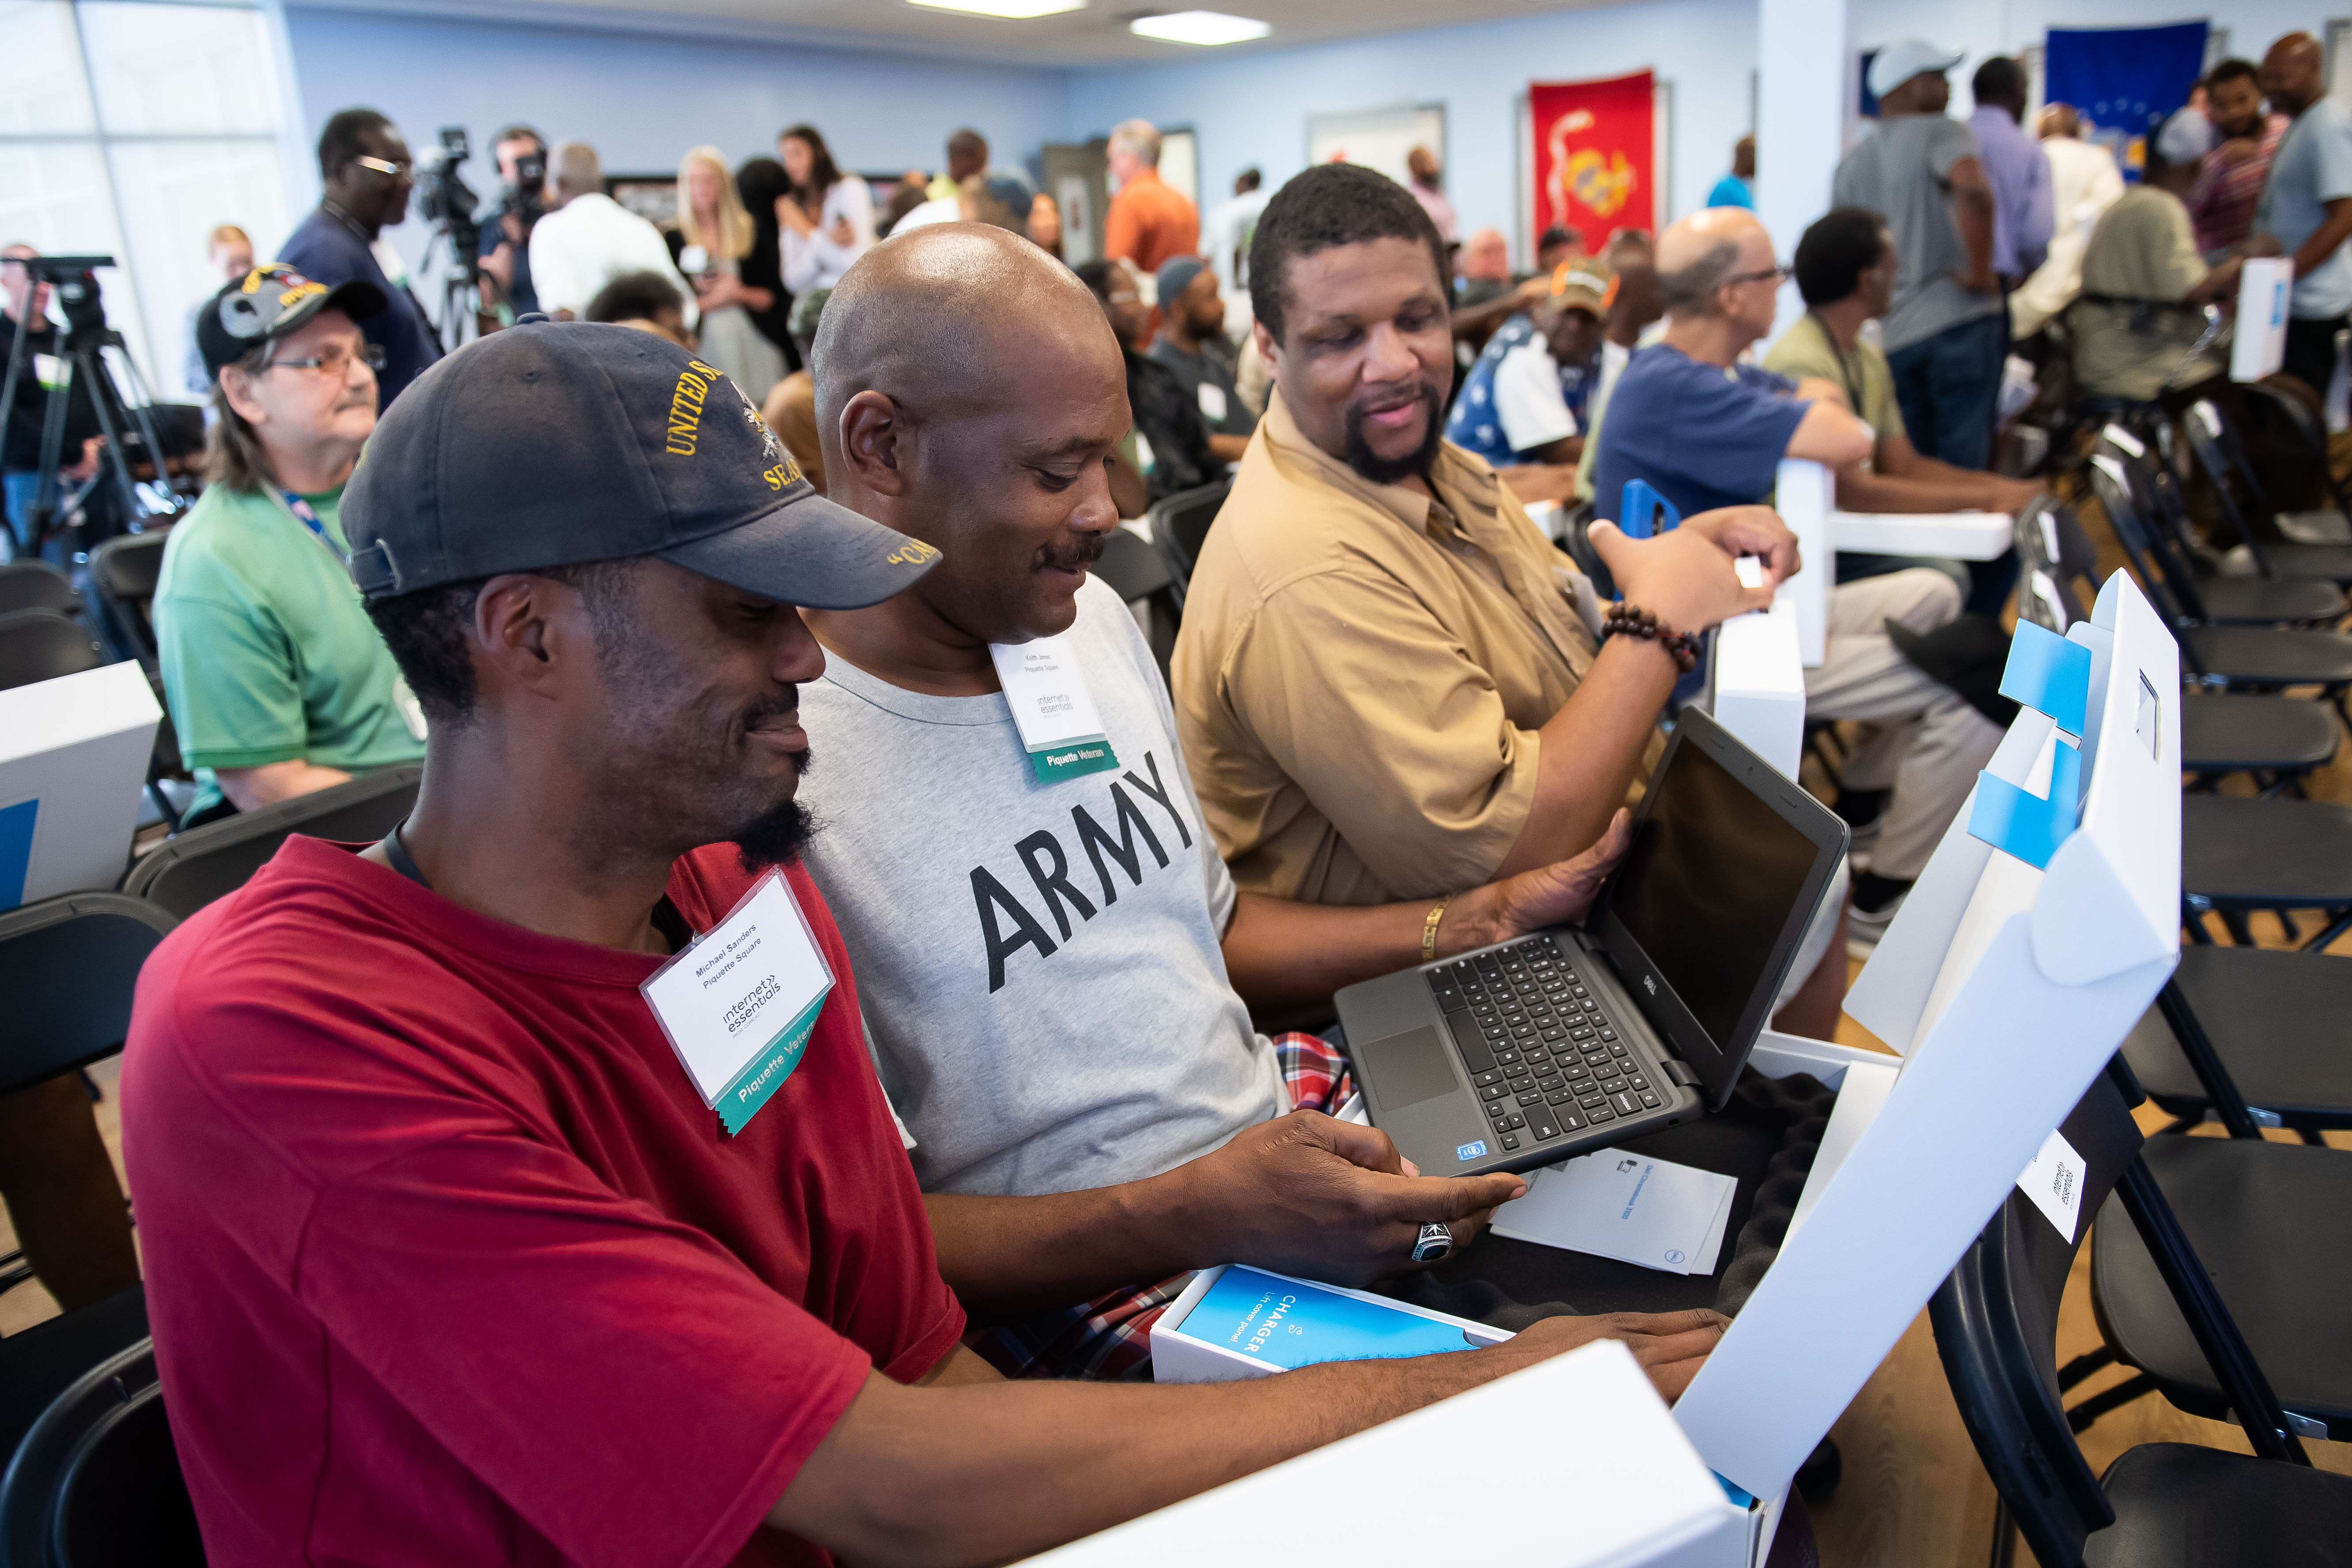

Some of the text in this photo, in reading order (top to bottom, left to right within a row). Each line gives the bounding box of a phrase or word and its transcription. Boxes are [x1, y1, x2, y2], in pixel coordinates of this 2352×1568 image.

[666, 361, 724, 456] UNITED S
[763, 458, 802, 490] SEA
[1037, 693, 1065, 706] internet
[1041, 701, 1073, 714] essentials
[1046, 749, 1104, 767] Piquette Veteran
[970, 750, 1192, 994] ARMY
[696, 924, 756, 978] Michael Sanders
[703, 937, 761, 990] Piquette Square
[723, 979, 767, 1023] internet
[728, 981, 781, 1033] essentials
[738, 1054, 785, 1103] Piquette
[1569, 1117, 1577, 1126] enter
[1618, 1093, 1632, 1110] backspace
[2053, 1164, 2065, 1197] internet
[2062, 1169, 2073, 1205] essentials
[1227, 1291, 1275, 1343] Lift cover panel.
[1244, 1295, 1296, 1352] CHARGER
